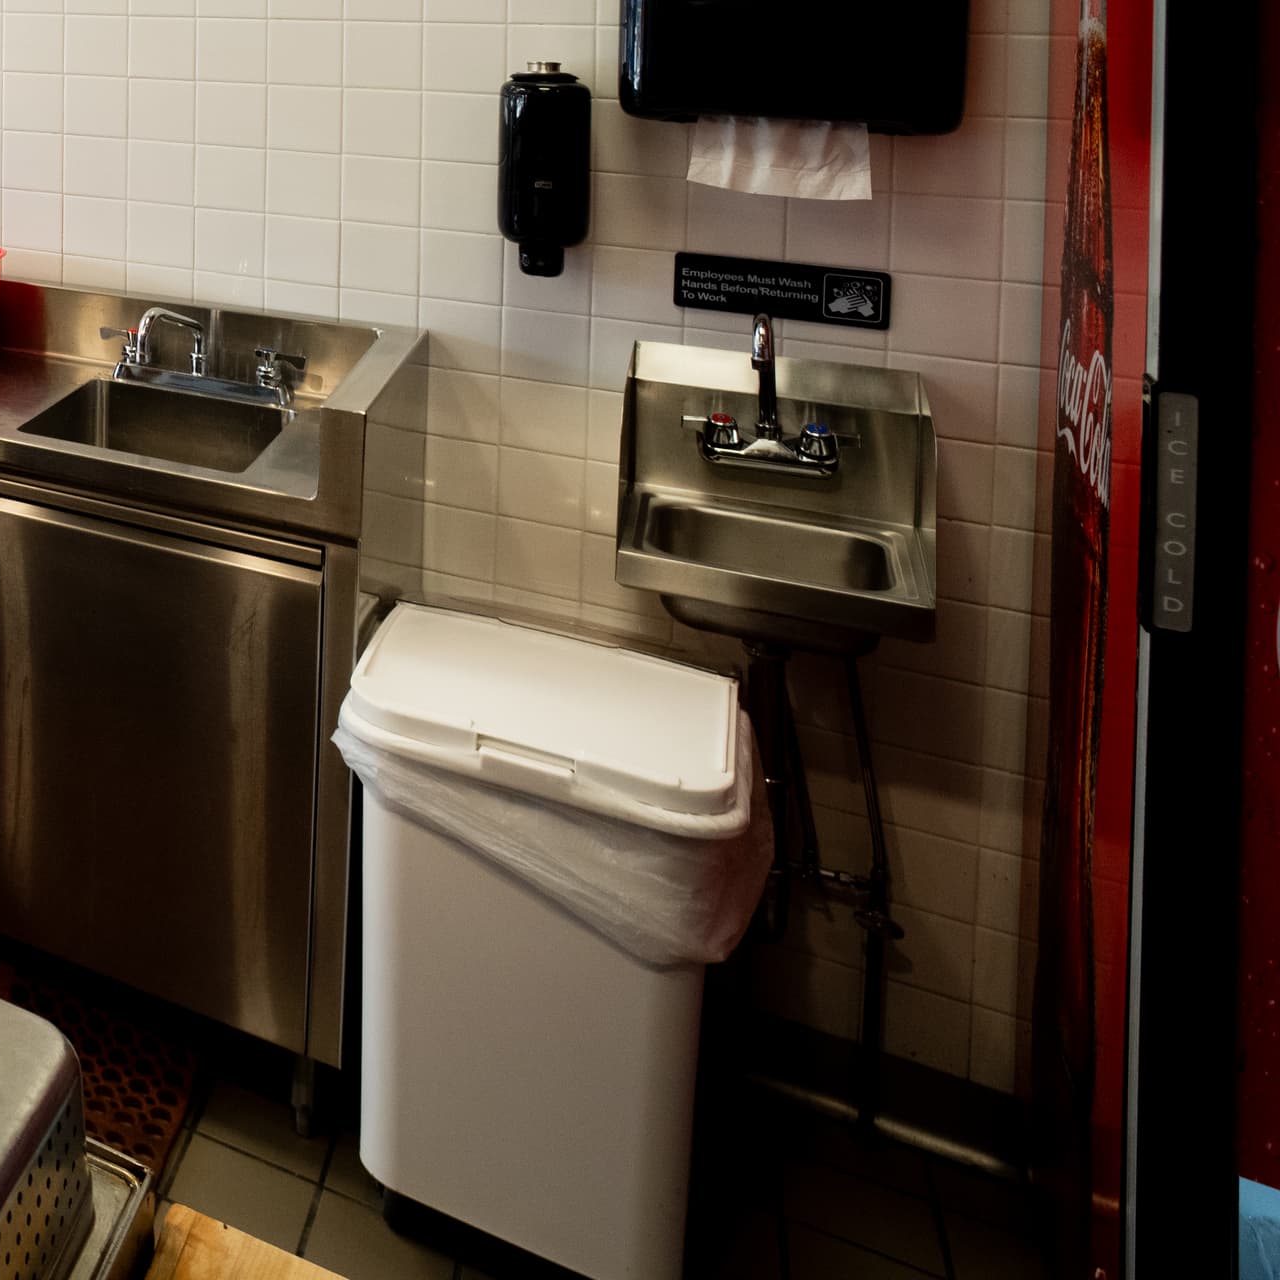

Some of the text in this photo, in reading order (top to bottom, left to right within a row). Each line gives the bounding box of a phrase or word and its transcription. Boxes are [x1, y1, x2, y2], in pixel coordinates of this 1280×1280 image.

[681, 267, 812, 289] Employees Must Wash
[681, 279, 819, 303] Hands Before Returning
[681, 289, 728, 303] To Work
[1167, 411, 1188, 484] ICE
[1163, 512, 1187, 614] COLD
